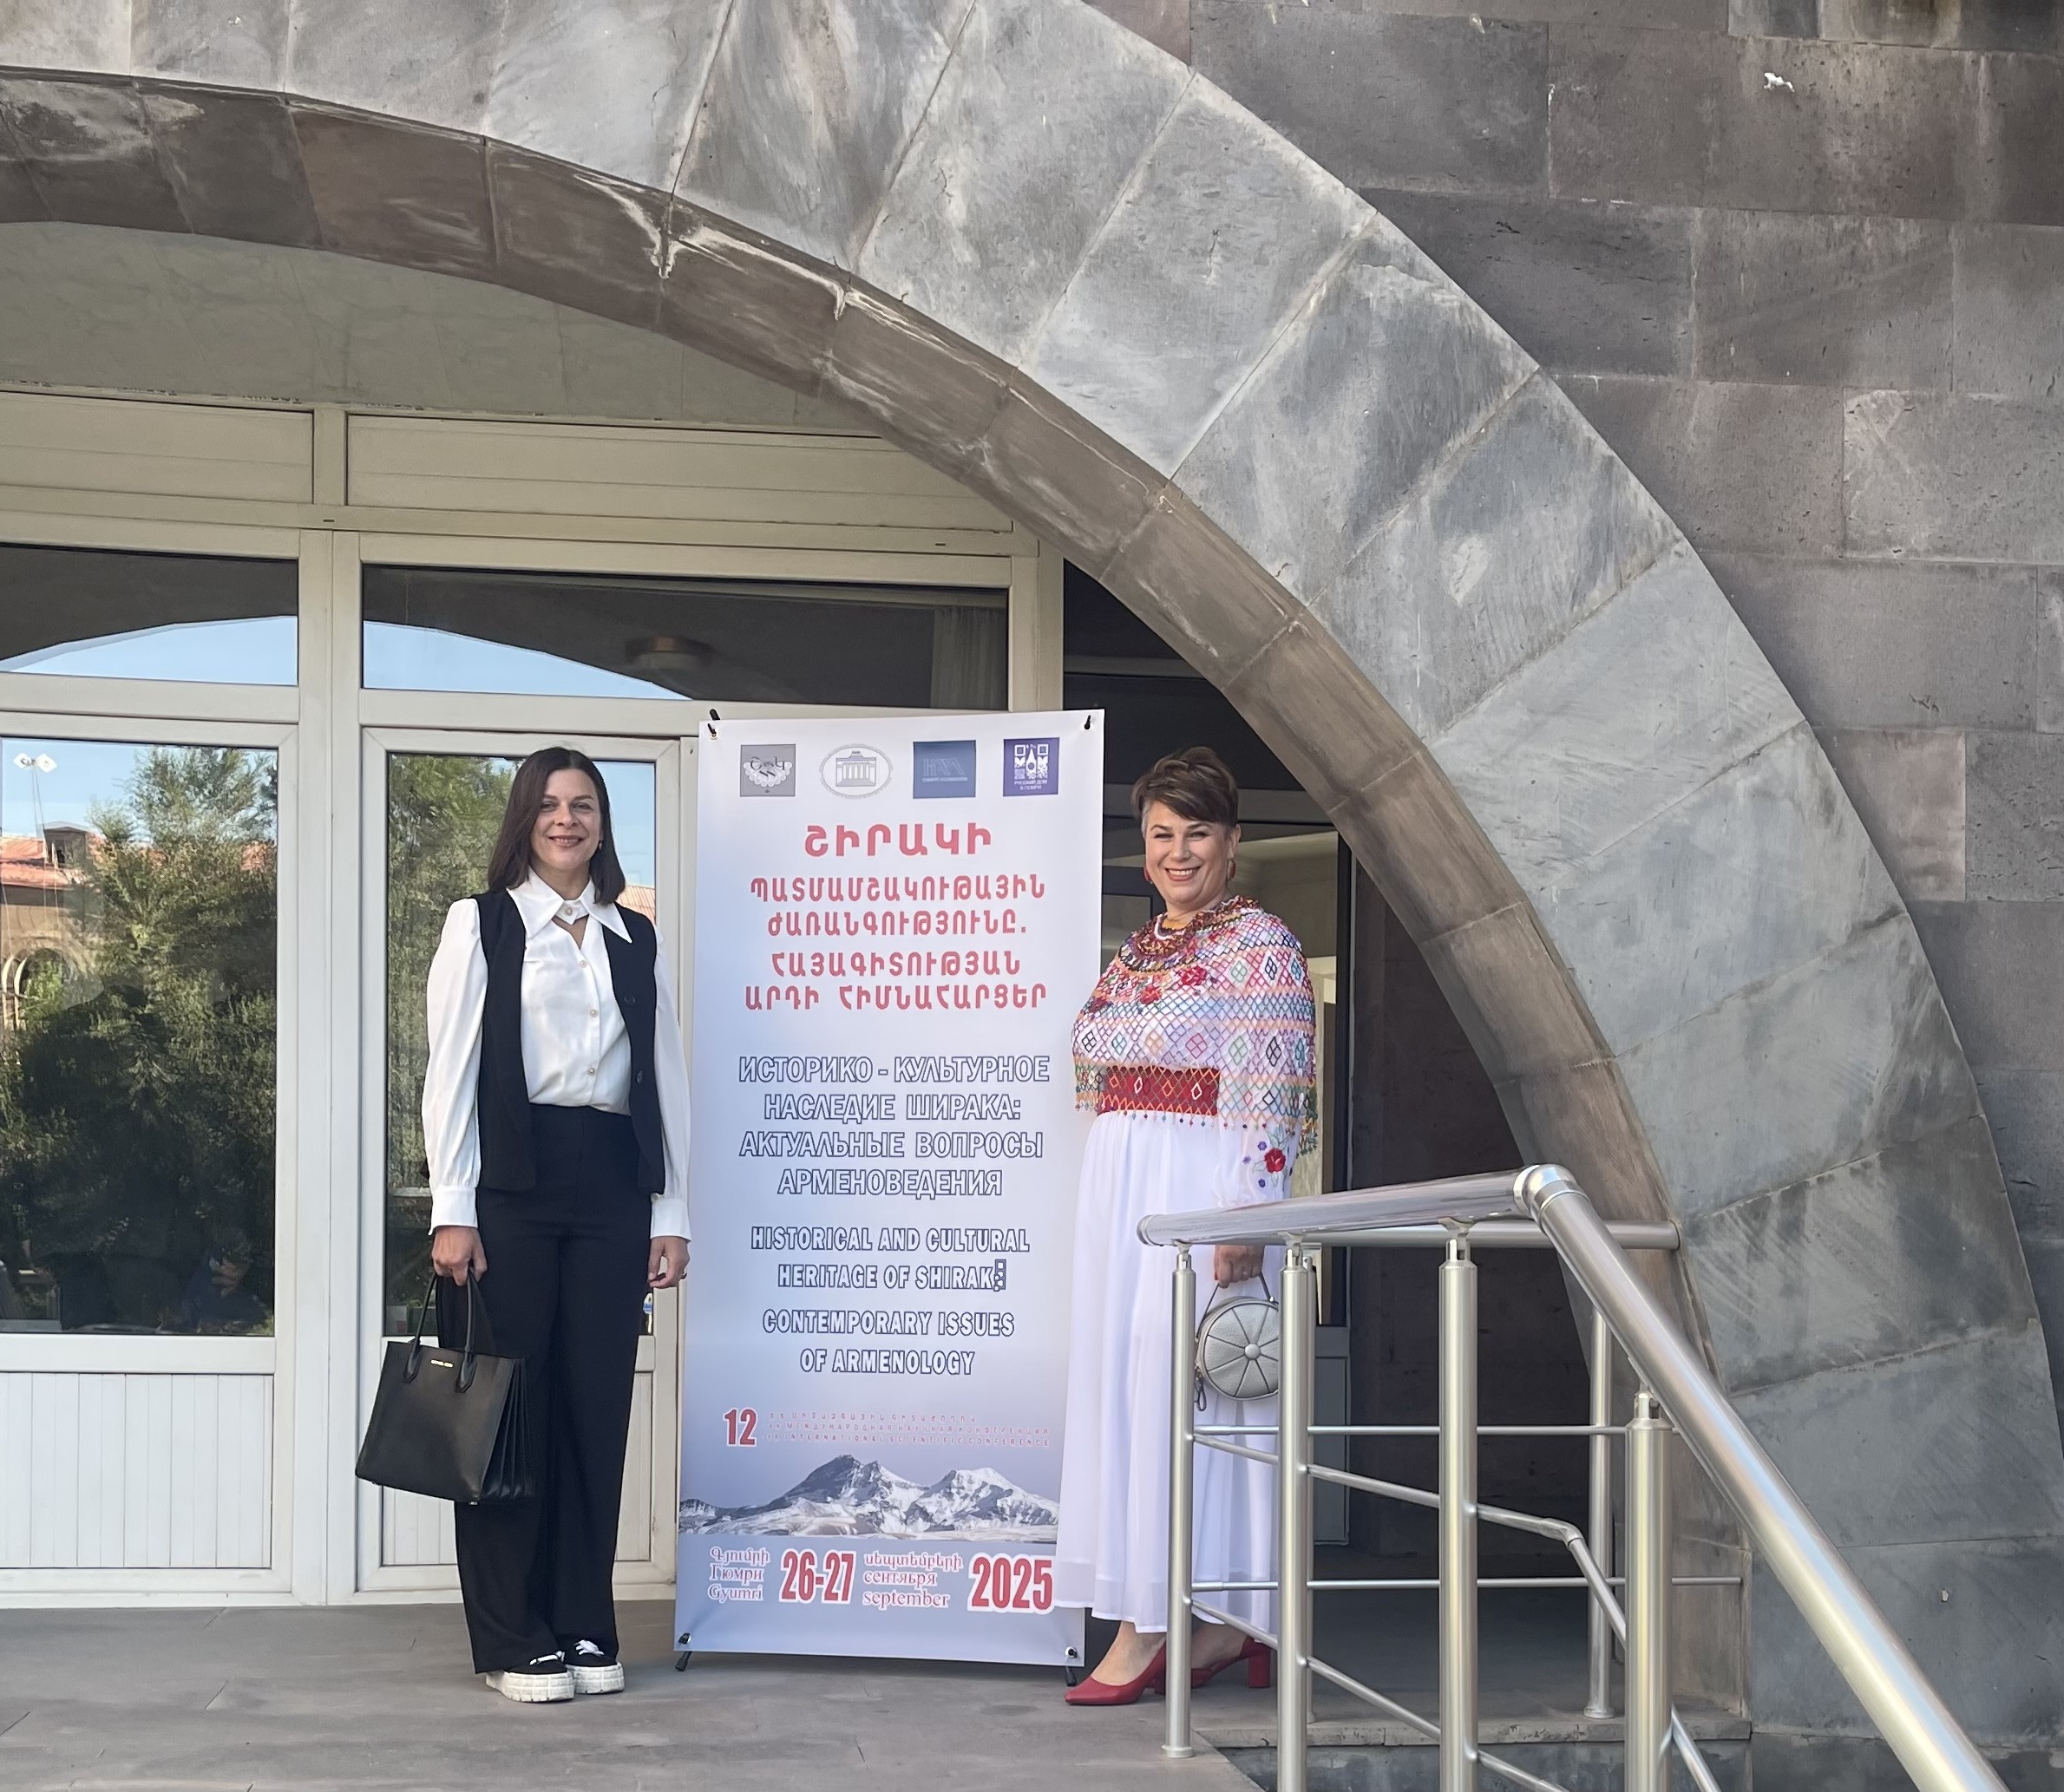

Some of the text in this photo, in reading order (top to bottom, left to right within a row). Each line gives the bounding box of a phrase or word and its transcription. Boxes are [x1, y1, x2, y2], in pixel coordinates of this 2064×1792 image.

[804, 821, 992, 858] ՇԻՐԱԿԻ
[750, 873, 1045, 902] ՊԱՏՄԱՄՇԱԿՈՒԹԱՅԻՆ
[768, 908, 1026, 937] ԺԱՌԱՆԳՈՒԹՅՈՒՆԸ.
[771, 950, 1020, 977] ՀԱՅԱԳԻՏՈՒԹՅԱՆ
[745, 983, 1046, 1010] ԱՐԴԻ ՀԻՄՆԱՀԱՐՑԵՐ
[738, 1056, 874, 1083] ИСТОРИКО
[894, 1055, 1051, 1083] КУЛЬТУРНОЕ
[763, 1093, 1021, 1125] НАСЛЕДИЕ ШИРАКА:
[737, 1130, 1044, 1159] АКТУАЛЬНЫЕ ВОПРОСЫ
[776, 1167, 1003, 1201] АРМЕНОВЕДЕНИЯ
[750, 1226, 1031, 1253] HISTORICAL AND CULTURAL
[777, 1263, 878, 1289] HERITAGE
[882, 1264, 911, 1290] OF
[762, 1308, 1015, 1337] CONTEMPORARY ISSUES
[799, 1347, 976, 1376] OF ARMENOLOGY
[725, 1409, 756, 1445] 12
[711, 1547, 769, 1565] Գյումրի
[710, 1565, 763, 1586] Гюмри
[782, 1551, 854, 1601] 26-27
[864, 1571, 935, 1588] сентября
[971, 1556, 1053, 1611] 2025
[708, 1586, 763, 1601] Gyumri
[863, 1589, 949, 1608] september
